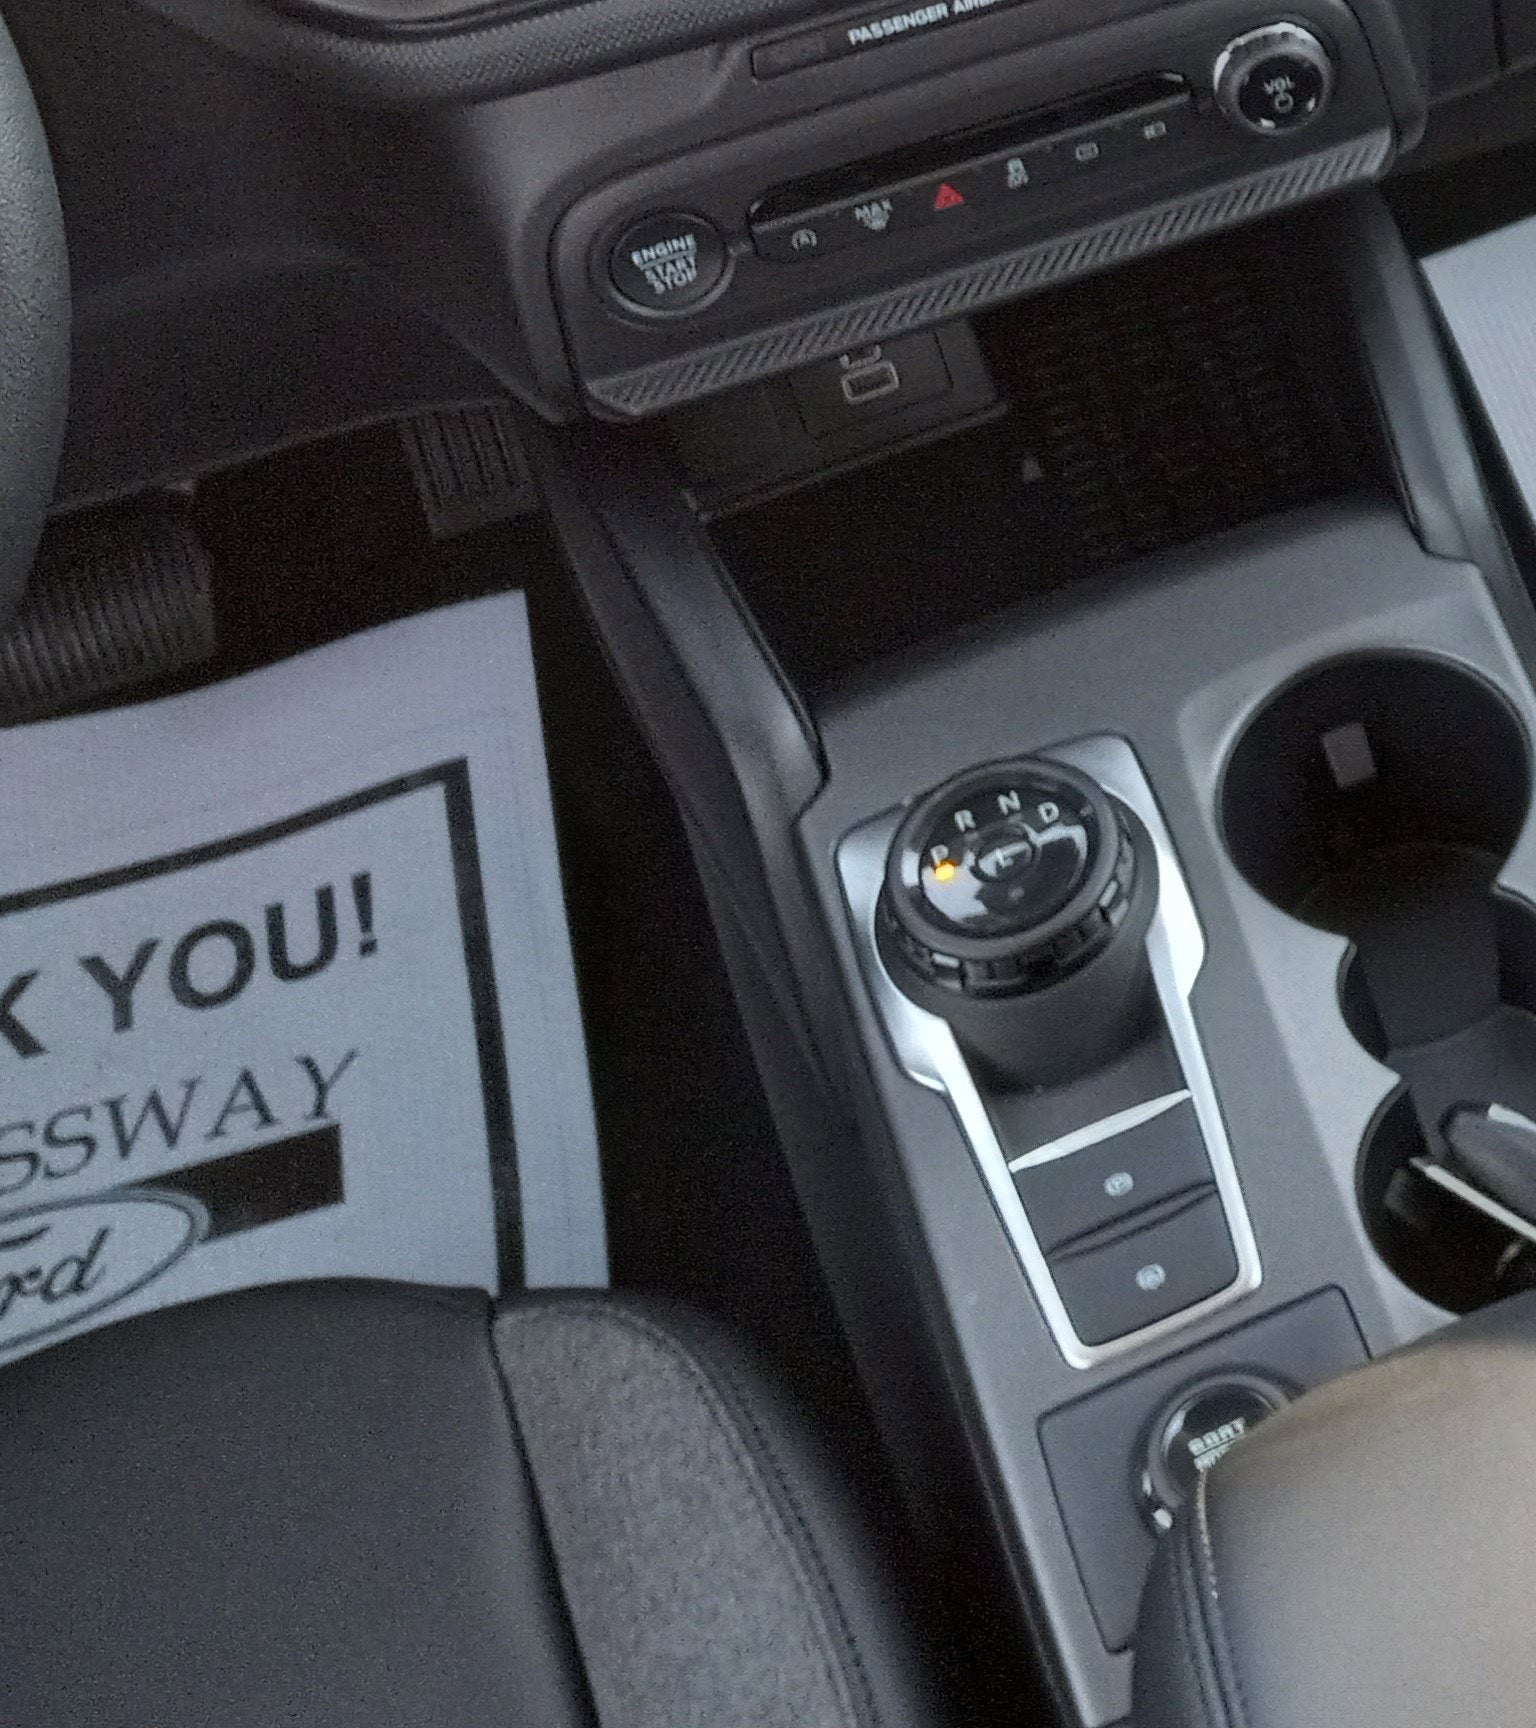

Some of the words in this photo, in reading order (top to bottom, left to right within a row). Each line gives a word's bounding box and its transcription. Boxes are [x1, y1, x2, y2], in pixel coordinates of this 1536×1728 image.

[847, 2, 950, 46] PASSENGER
[1263, 74, 1296, 95] VOL
[631, 232, 697, 268] ENGINE
[997, 789, 1022, 816] N
[1036, 801, 1060, 824] D
[78, 871, 381, 1035] YOU!
[0, 1048, 359, 1198] SSWAY
